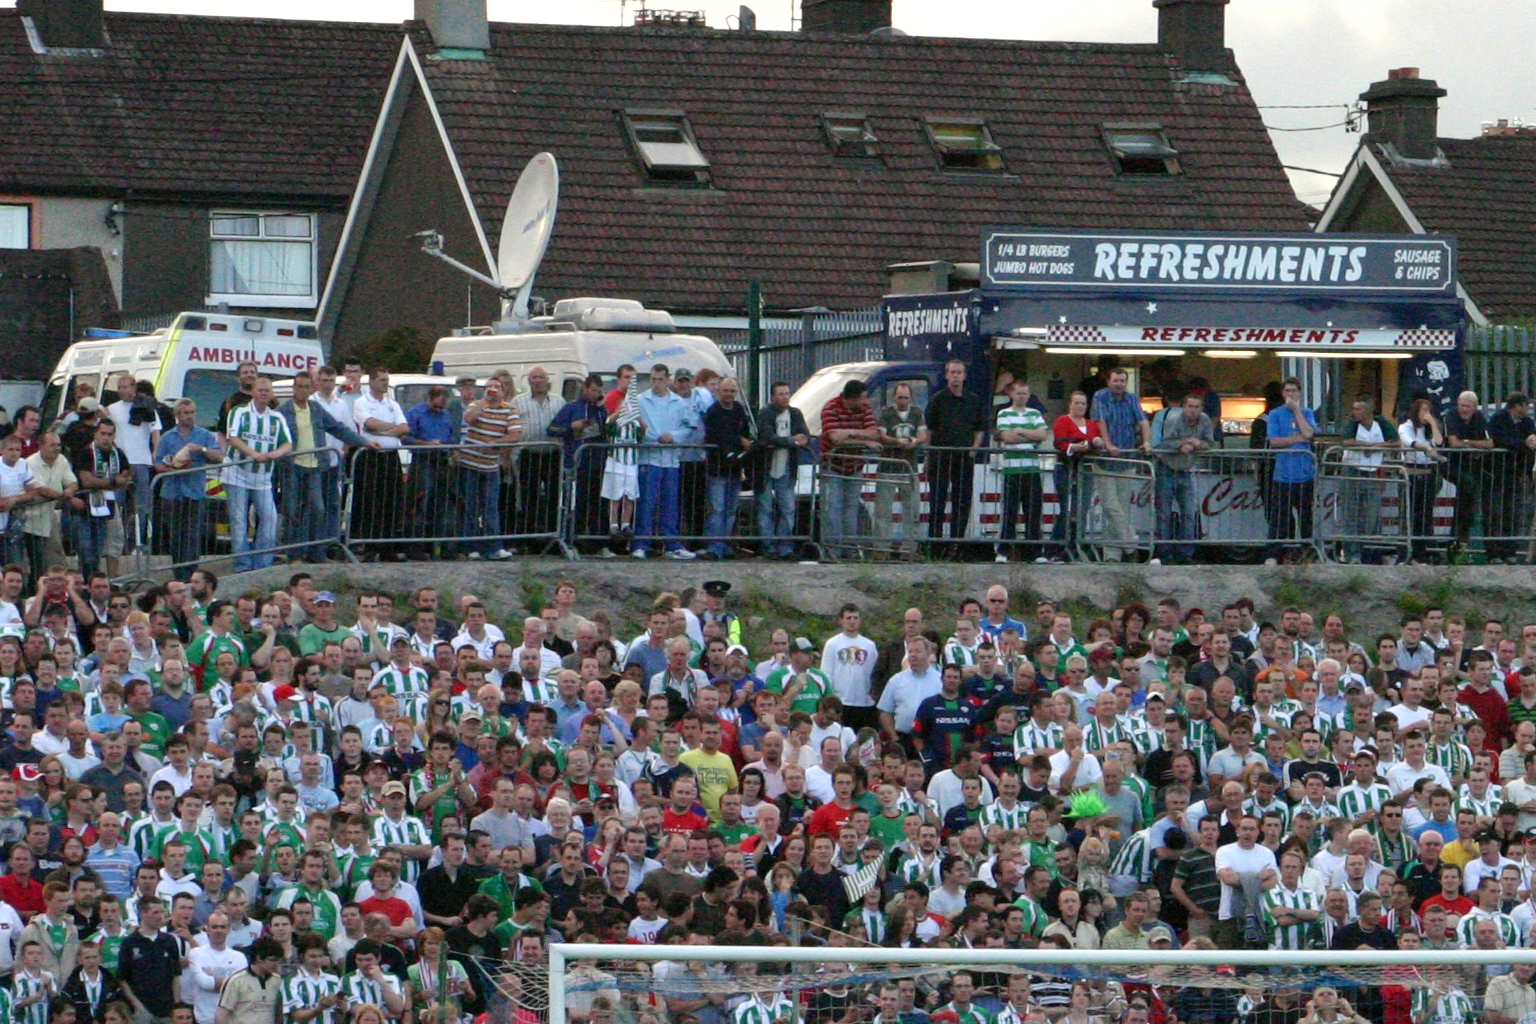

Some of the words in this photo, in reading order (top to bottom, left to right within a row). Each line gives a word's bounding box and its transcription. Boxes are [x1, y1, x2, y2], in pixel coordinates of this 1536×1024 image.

[1016, 244, 1027, 257] LB
[1029, 245, 1070, 258] BURGERS
[1394, 249, 1441, 264] SAUSAGE
[993, 262, 1026, 274] JUMBO
[1028, 262, 1047, 274] HOT
[1050, 263, 1074, 275] DOGS
[1094, 243, 1367, 282] REFRESHMENTS
[1395, 266, 1403, 280] &
[1406, 266, 1440, 280] CHIPS
[888, 308, 968, 337] REFRESHMENTS
[1141, 327, 1359, 344] REFRESHMENTS
[187, 346, 319, 371] AMBULANCE
[935, 717, 971, 727] NISSAN
